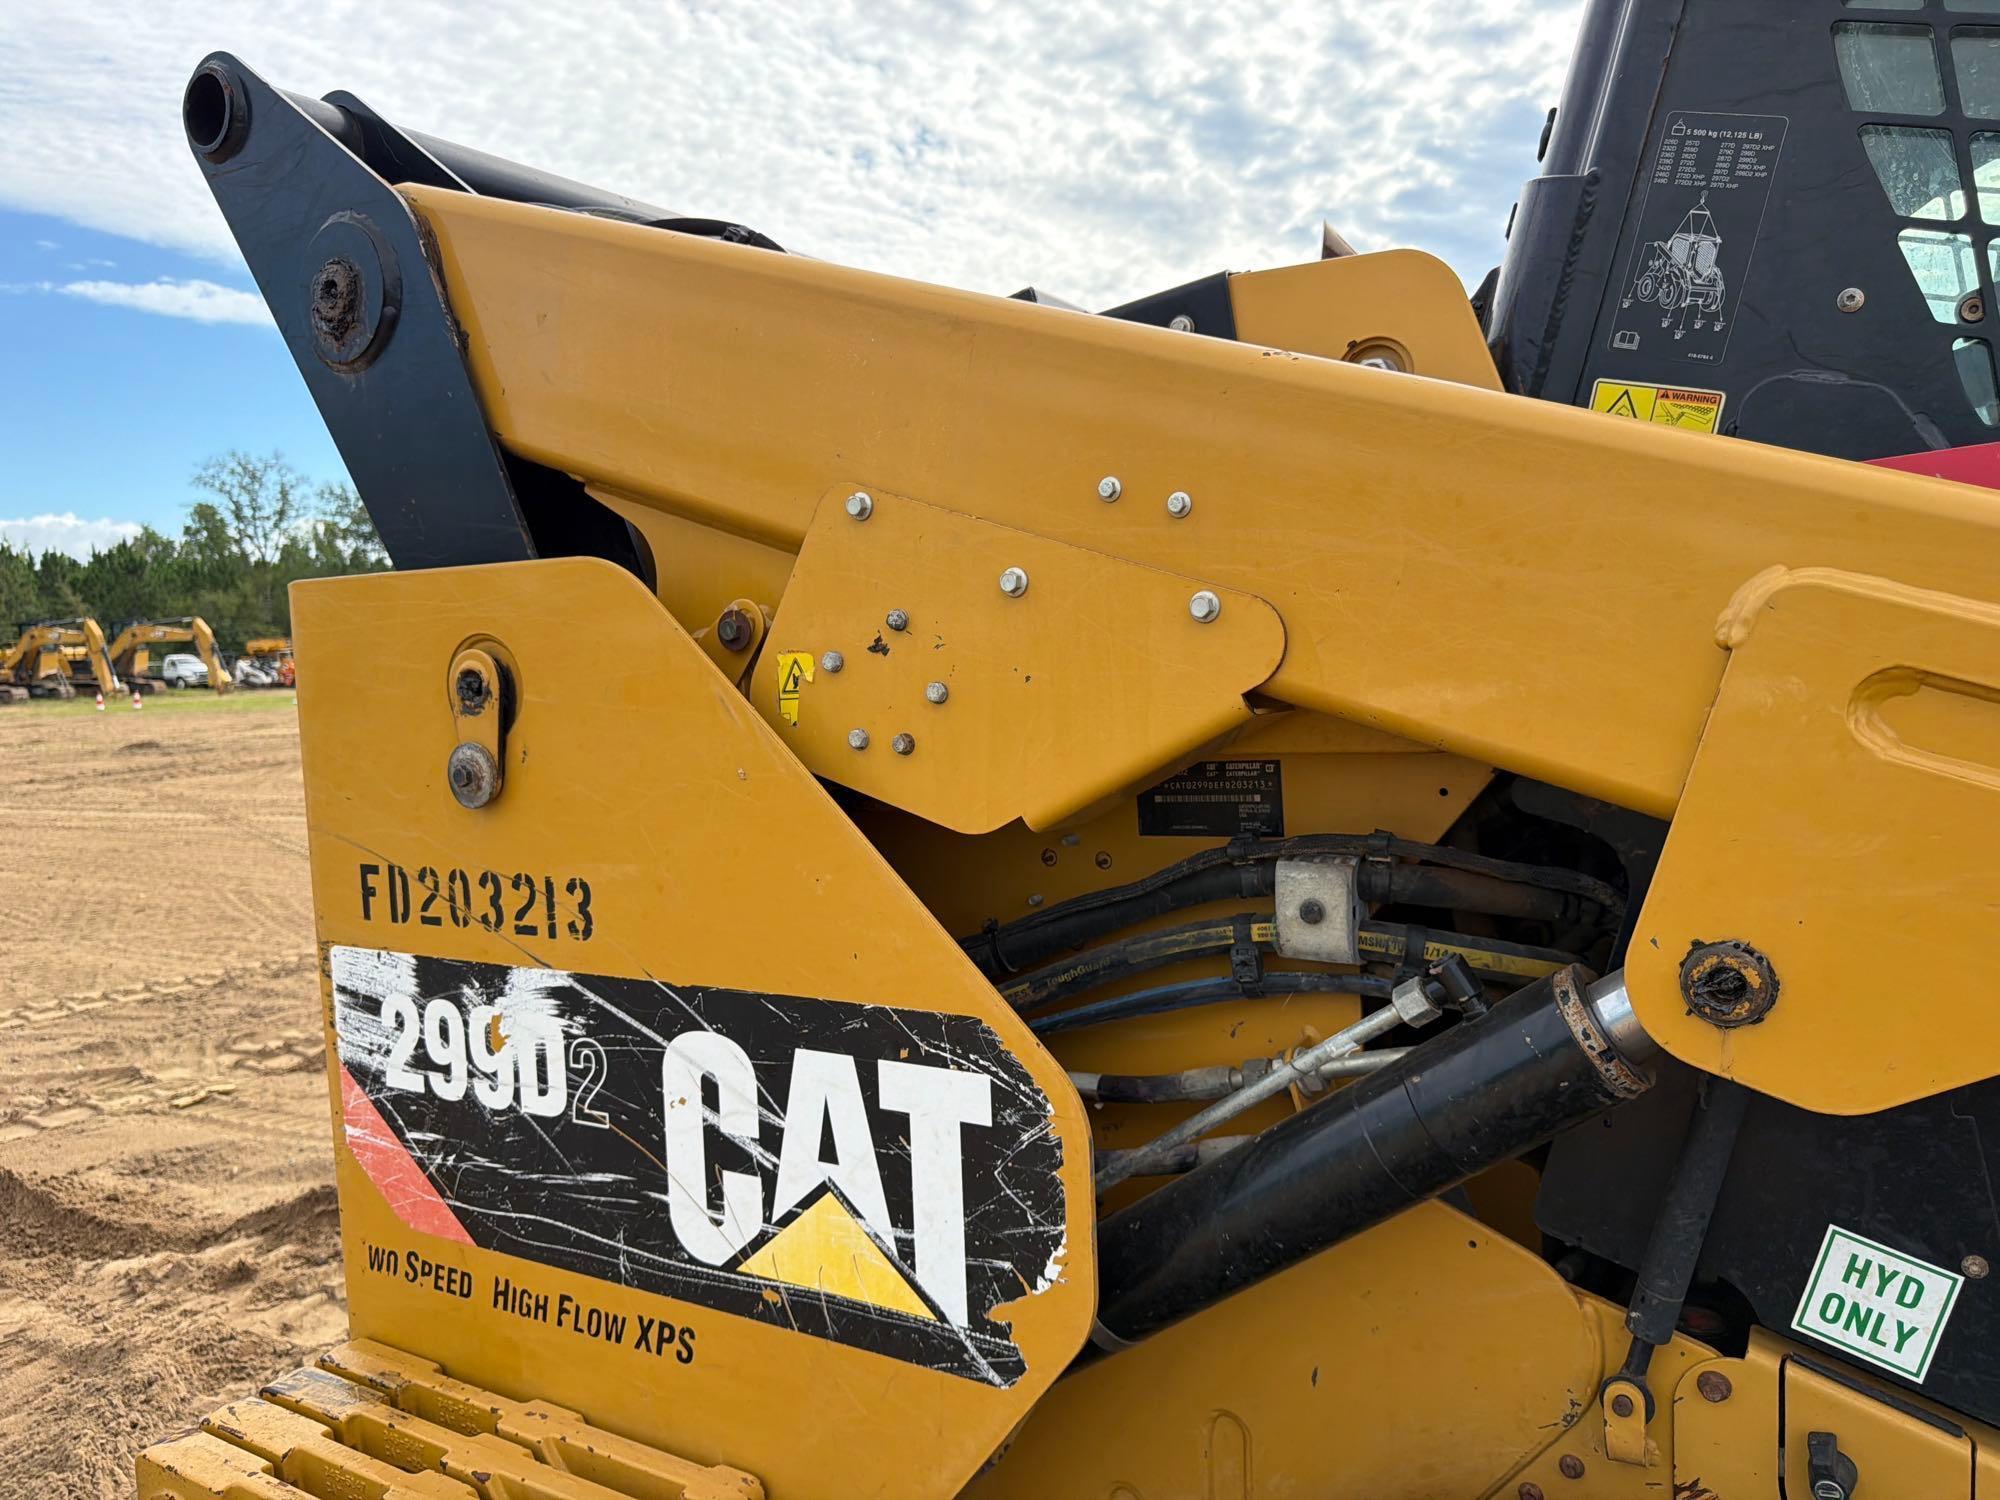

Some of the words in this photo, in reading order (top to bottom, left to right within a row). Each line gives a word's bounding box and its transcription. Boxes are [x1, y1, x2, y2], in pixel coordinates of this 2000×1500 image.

[1708, 130, 1718, 138] kg
[1749, 132, 1763, 141] LB)
[1672, 392, 1717, 404] WARNING
[360, 863, 594, 942] FD203213
[662, 1030, 992, 1328] CAT
[404, 1250, 472, 1299] SPEED
[493, 1275, 550, 1324] HIGH
[556, 1293, 627, 1345] FLOW
[634, 1314, 696, 1365] XPS
[1841, 1252, 1925, 1310] HYD
[1818, 1292, 1920, 1354] ONLY
